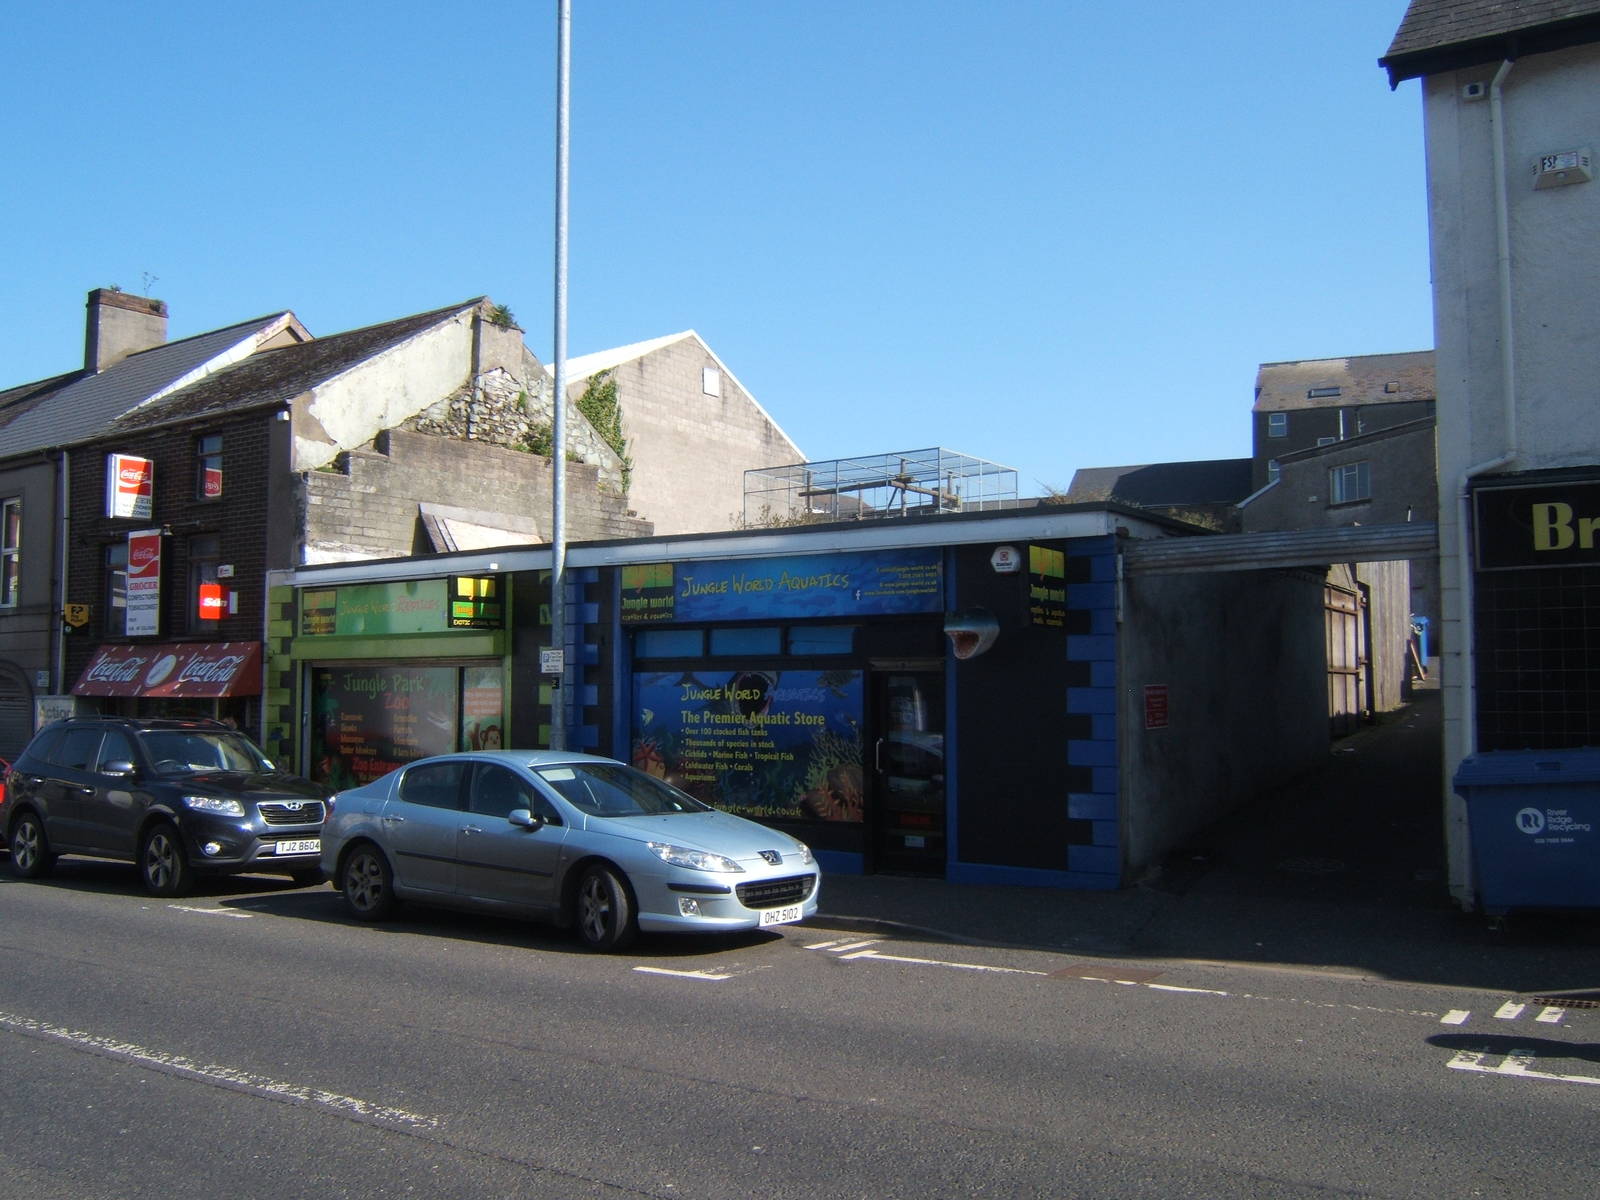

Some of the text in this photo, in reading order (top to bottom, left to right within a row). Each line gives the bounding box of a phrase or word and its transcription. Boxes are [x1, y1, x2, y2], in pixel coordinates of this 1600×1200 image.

[681, 569, 849, 598] JUNGLE WORLD AQUATICS
[343, 673, 425, 701] Jungle Park
[681, 683, 721, 701] JUNGLE
[724, 682, 761, 702] WORLD
[681, 710, 825, 728] The Premier Aquatic Store
[700, 728, 712, 736] 100
[713, 728, 736, 736] stocked
[738, 728, 750, 736] fish
[751, 729, 768, 737] tanks
[685, 738, 716, 747] Thousands
[718, 739, 724, 747] of
[726, 740, 749, 749] species
[713, 751, 734, 759] Marine
[735, 751, 748, 759] Fish
[754, 752, 779, 762] Tropical
[780, 752, 794, 761] Fish
[685, 761, 754, 772] Coldwater Fish Corals
[1547, 816, 1573, 825] Ridge
[1547, 822, 1591, 832] Recycling
[281, 841, 320, 852] TJZ 8604
[764, 907, 799, 924] OHZ 5102
